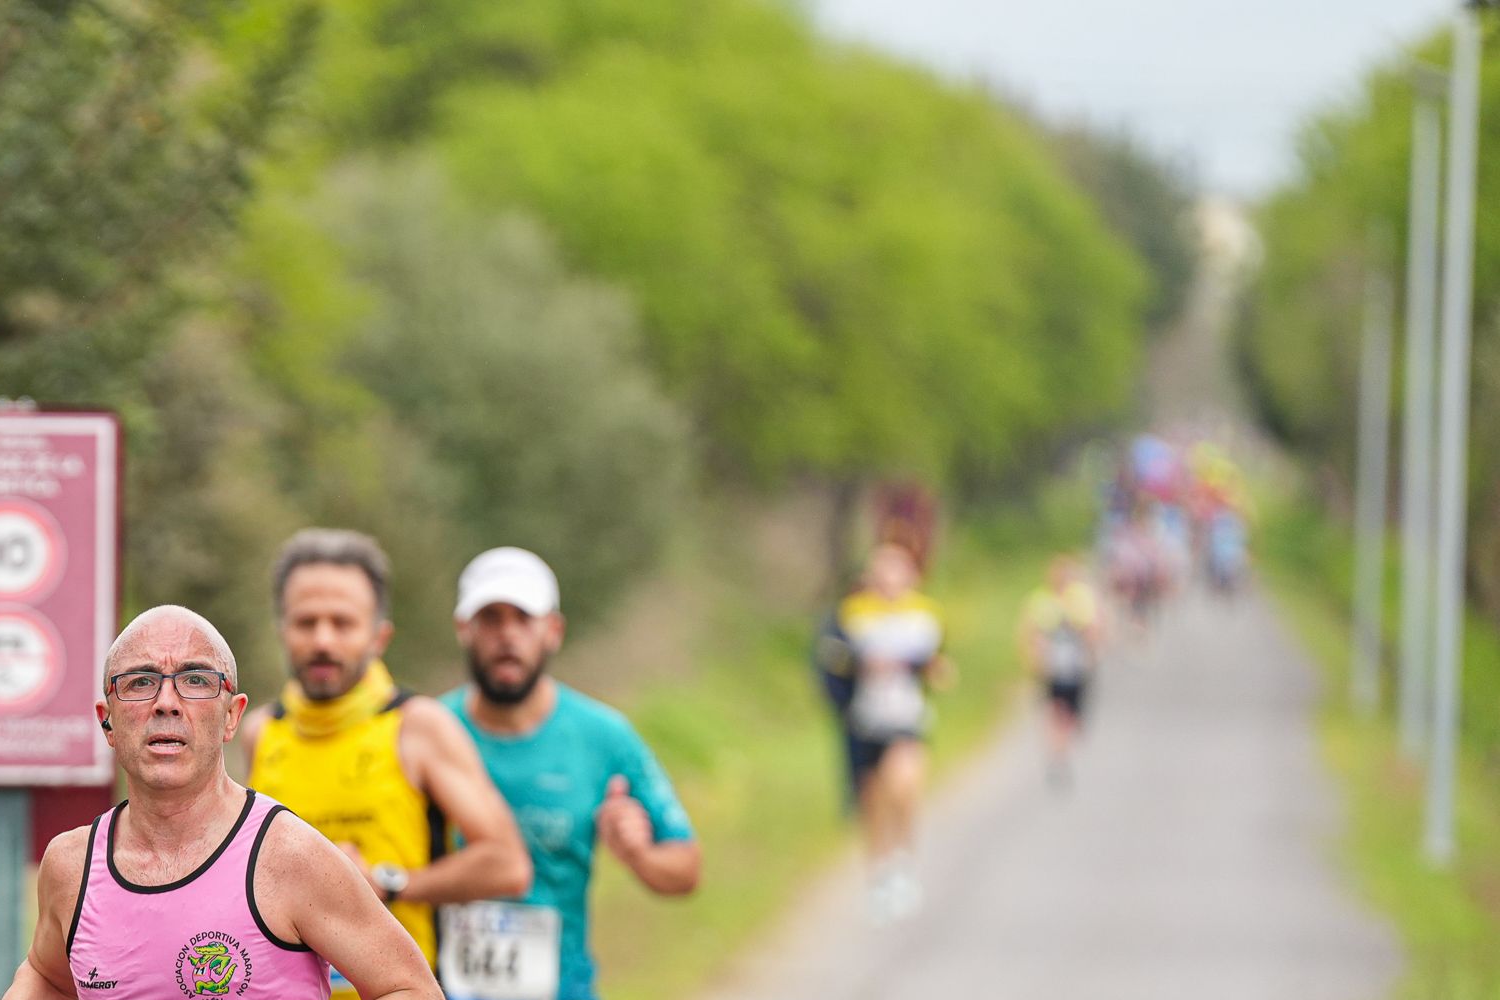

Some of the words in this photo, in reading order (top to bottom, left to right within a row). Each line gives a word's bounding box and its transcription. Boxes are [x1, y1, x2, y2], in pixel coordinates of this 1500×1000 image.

[175, 944, 196, 999] ASOCIACION
[189, 931, 240, 950] DEPORTIVA
[236, 948, 252, 996] MARATON
